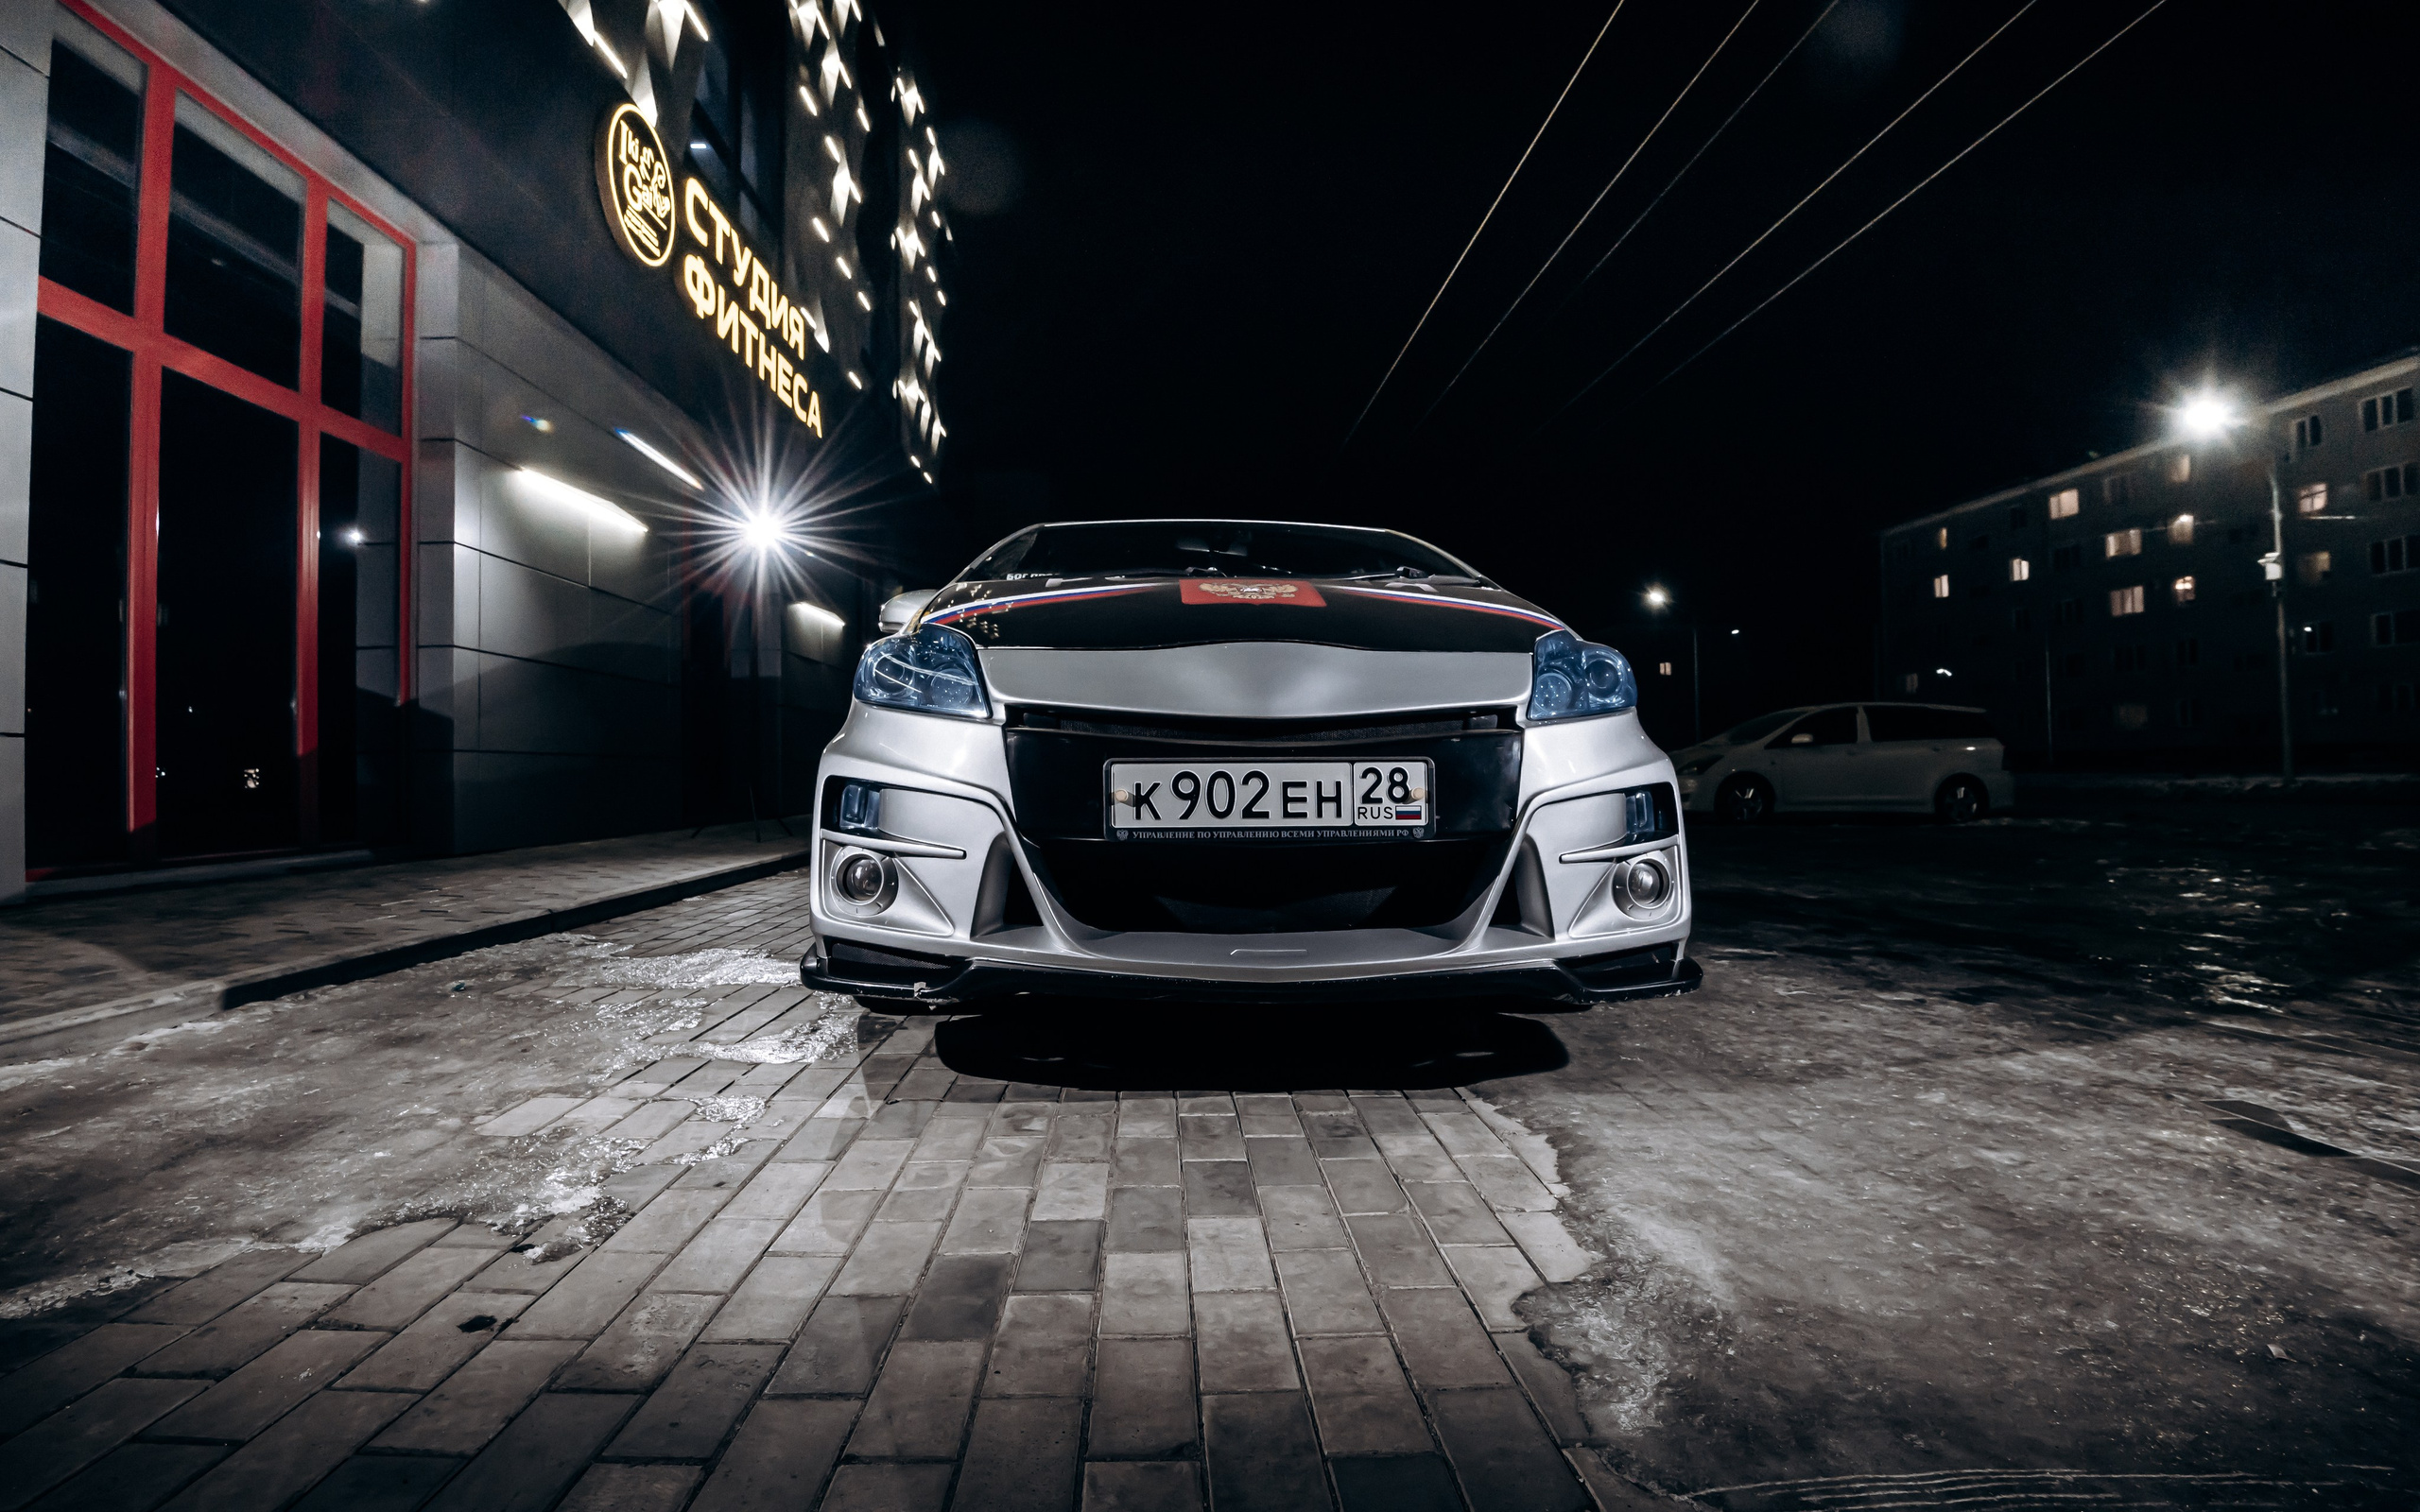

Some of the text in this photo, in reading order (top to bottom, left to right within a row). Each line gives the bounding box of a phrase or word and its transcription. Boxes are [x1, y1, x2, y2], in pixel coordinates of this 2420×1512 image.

[684, 177, 804, 361] СТУДИЯ
[683, 253, 822, 438] ФИТНЕСА
[1360, 766, 1410, 804] 28
[1357, 806, 1393, 819] RUS
[1132, 829, 1409, 839] УПРАВЛЕНИЕ ПО УПРАВЛЕНИЮ ВСЕМИ УПРАВЛЕНИЯМИ РФ
